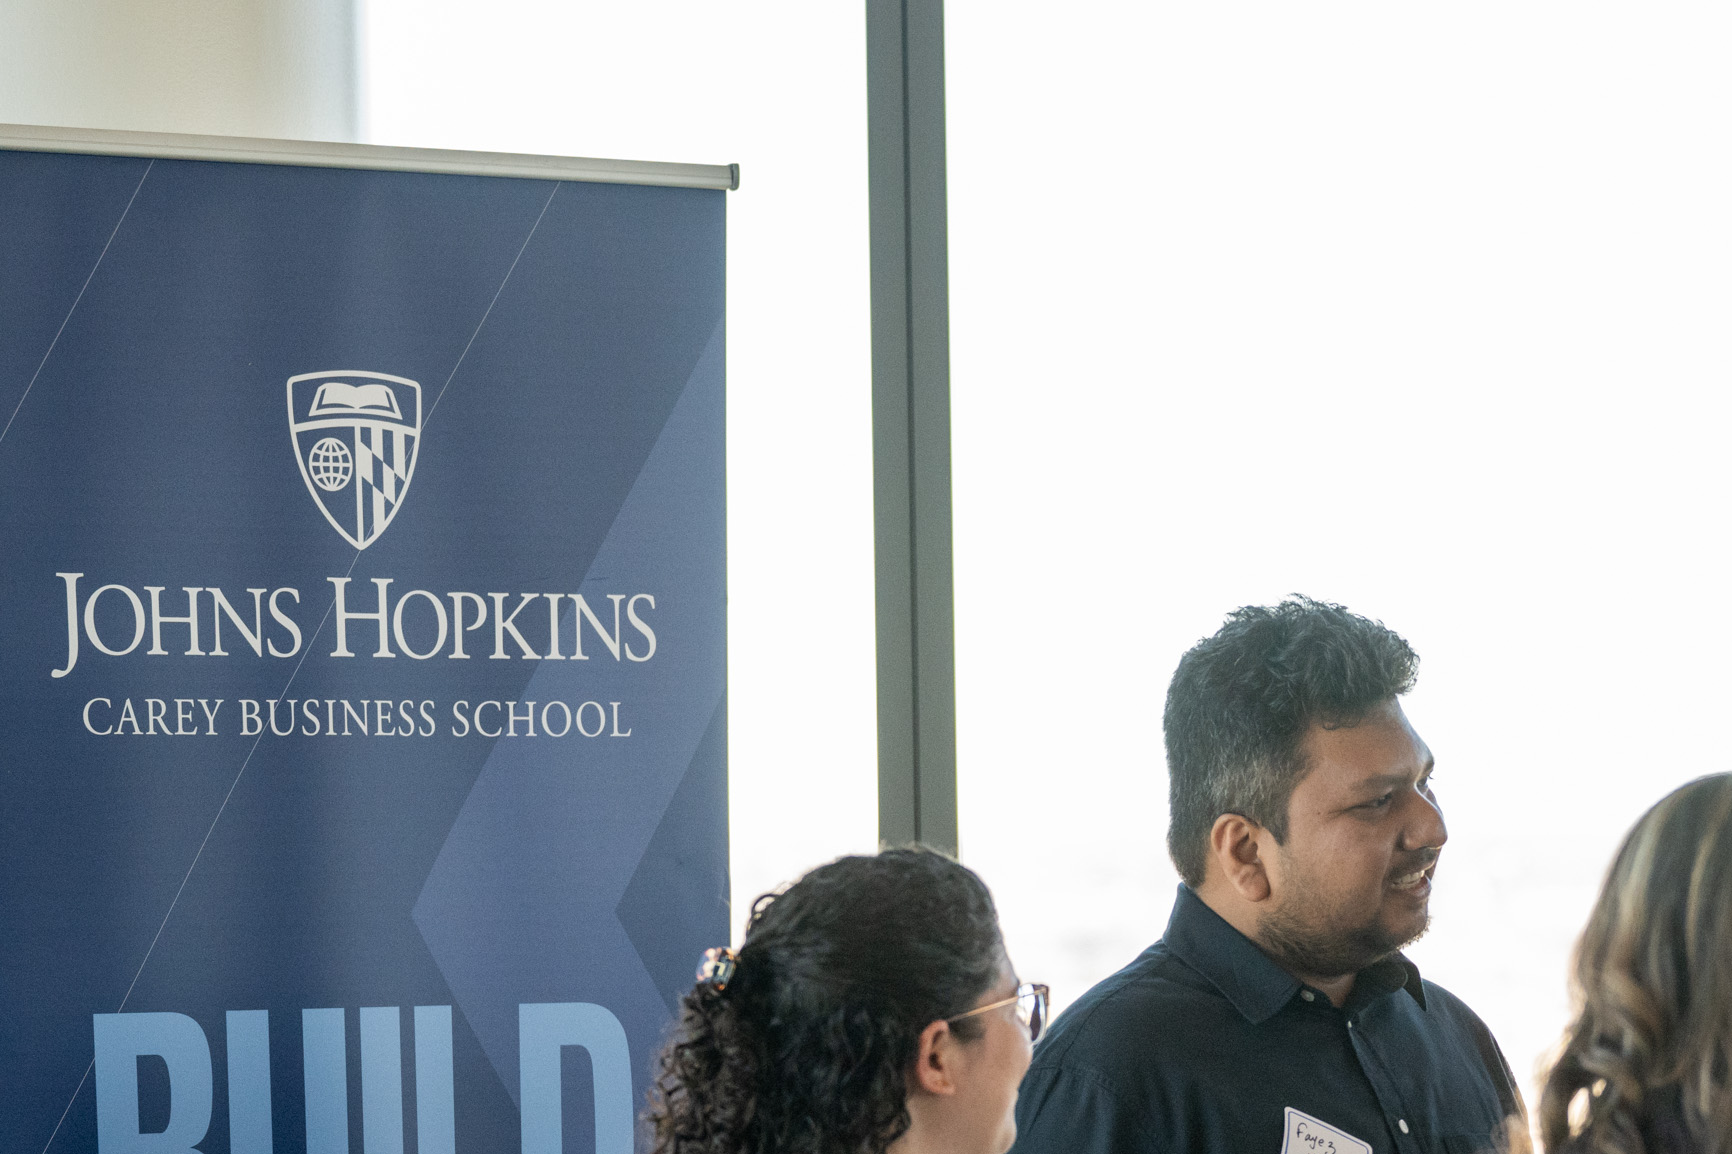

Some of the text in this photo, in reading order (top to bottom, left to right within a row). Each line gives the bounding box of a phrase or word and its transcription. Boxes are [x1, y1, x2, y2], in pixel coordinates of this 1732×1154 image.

[51, 572, 657, 678] JOHNS HOPKINS
[83, 697, 632, 738] CAREY BUSINESS SCHOOL
